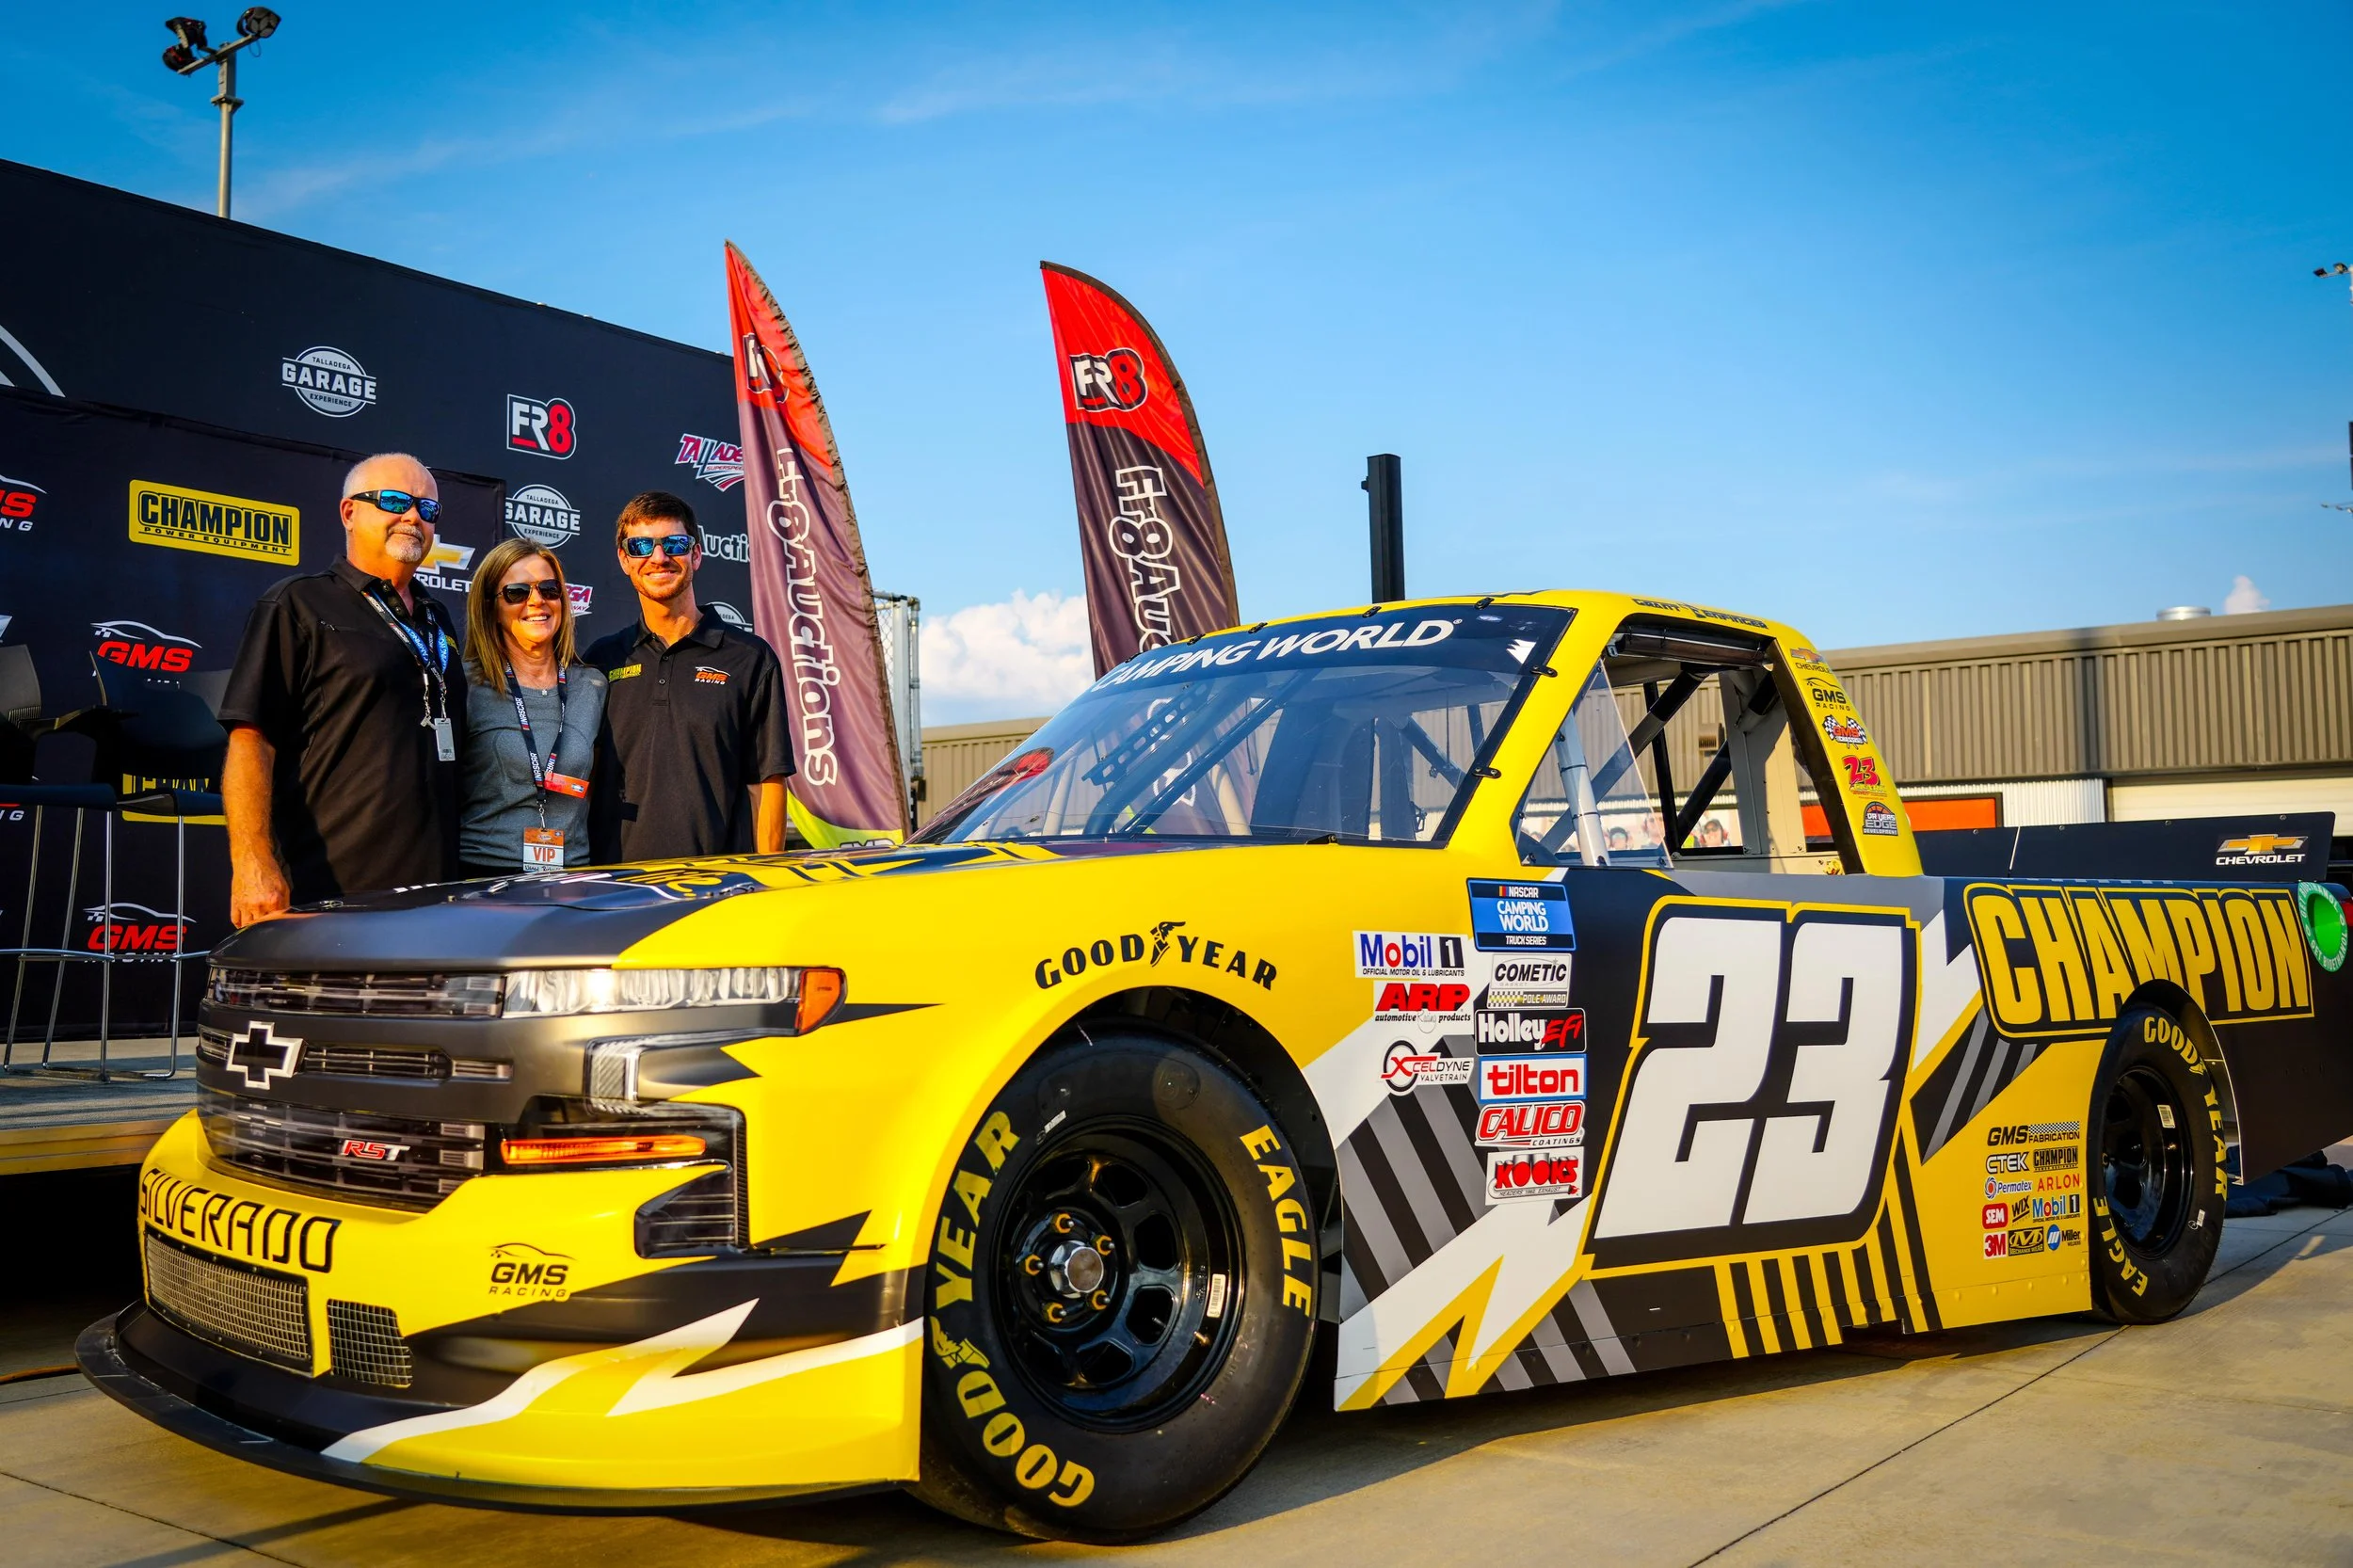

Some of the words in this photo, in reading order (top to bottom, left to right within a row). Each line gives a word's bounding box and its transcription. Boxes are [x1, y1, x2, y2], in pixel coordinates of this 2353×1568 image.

[312, 357, 351, 370] TALLADEGA
[282, 362, 376, 400] GARAGE
[1074, 358, 1142, 406] FR8
[310, 393, 352, 407] EXPERIENCE
[512, 401, 571, 453] FR8
[678, 436, 743, 467] TALLADE
[526, 494, 559, 505] TALLADEGA
[141, 494, 289, 545] CHAMPION
[144, 527, 195, 539] POWER
[203, 536, 289, 553] EQUIPMENT
[524, 528, 560, 539] EXPERIENCE
[97, 640, 193, 673] GMS
[1090, 638, 1251, 693] CAMPING
[1257, 619, 1454, 659] WORLD
[696, 671, 728, 680] GMS
[1812, 689, 1846, 704] GMS
[1817, 702, 1850, 712] RACING
[1842, 756, 1881, 785] 23
[1865, 820, 1897, 829] EDGE
[533, 847, 555, 862] VIP
[2216, 854, 2305, 866] CHEVROLET
[1509, 887, 1539, 898] NASCAR
[1497, 901, 1546, 915] CAMPING
[1499, 915, 1548, 932] WORLD
[88, 925, 187, 950] GMS
[1506, 935, 1526, 945] TRUCK
[1526, 936, 1546, 945] SERIES
[1360, 934, 1433, 968] Mobil
[1972, 895, 2309, 1025] CHAMPION
[1495, 963, 1567, 982] COMETIC
[1375, 983, 1470, 1012] ARP
[1522, 993, 1541, 1004] POLE
[1542, 994, 1566, 1004] AWARD
[1375, 1013, 1416, 1022] automotive
[1438, 1013, 1471, 1023] products
[1479, 1013, 1546, 1050] Holley
[1487, 1064, 1578, 1096] tilton
[1593, 917, 1902, 1239] 23
[1480, 1104, 1582, 1138] CALICO
[1532, 1138, 1580, 1146] COATINGS
[1987, 1126, 2028, 1146] GMS
[2029, 1132, 2080, 1144] FABRICATION
[340, 1140, 410, 1161] RST
[2034, 1147, 2077, 1166] CHAMPION
[1495, 1157, 1578, 1189] KOOKS
[1987, 1153, 2028, 1174] CTEK
[1997, 1181, 2032, 1194] Permatex
[2038, 1174, 2080, 1192] ARLON
[1986, 1208, 2005, 1224] SEM
[2012, 1195, 2029, 1217] WIX
[2033, 1195, 2065, 1218] Mobil
[139, 1168, 343, 1273] SILVERADO
[1240, 1125, 1313, 1317] EAGLE
[1985, 1234, 2006, 1256] 3M
[2061, 1229, 2080, 1241] Miller
[2093, 1195, 2148, 1297] EAGLE
[491, 1263, 568, 1286] GMS
[488, 1286, 568, 1299] RACING
